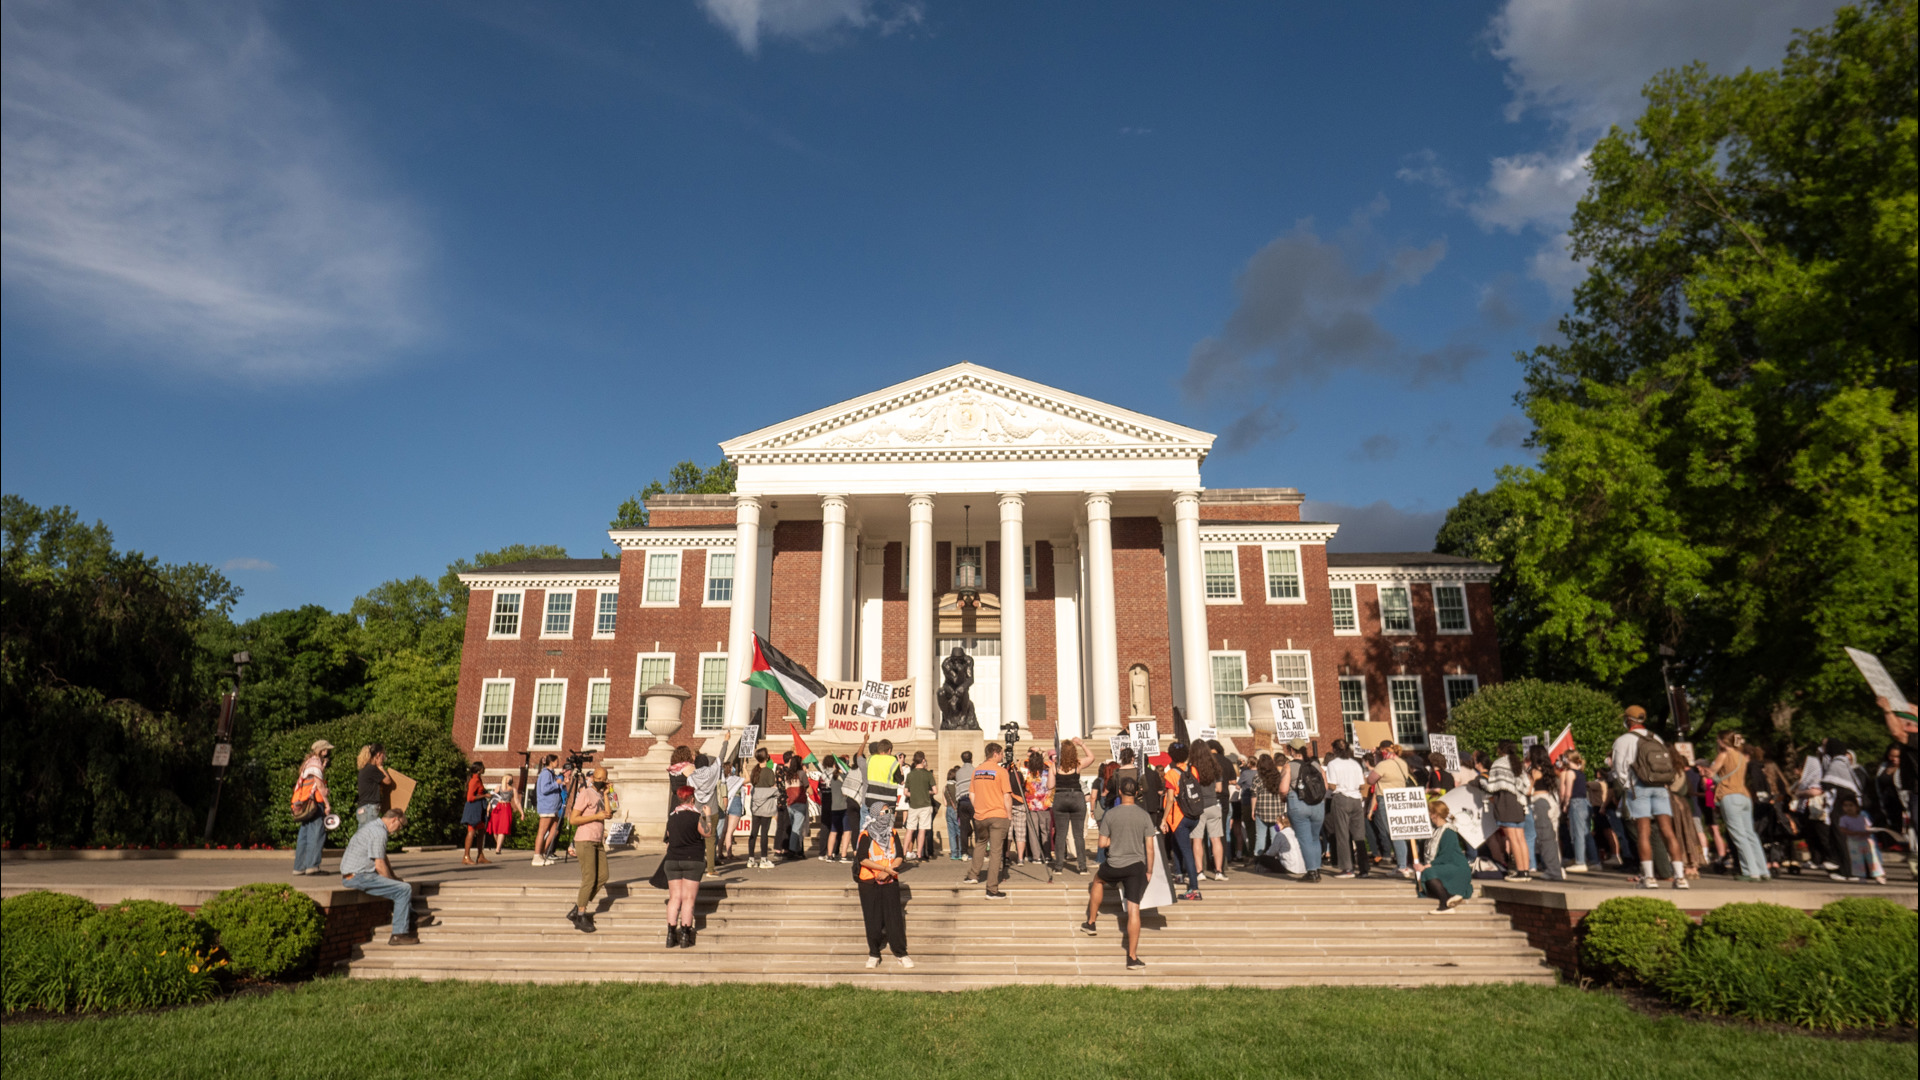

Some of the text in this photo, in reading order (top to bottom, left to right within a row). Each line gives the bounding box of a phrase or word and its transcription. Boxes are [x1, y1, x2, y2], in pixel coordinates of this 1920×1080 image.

[830, 688, 854, 700] LIFT
[892, 685, 912, 699] EGE
[866, 680, 890, 696] FREE
[862, 690, 889, 702] PALESTINE
[1278, 699, 1294, 709] END
[832, 703, 848, 716] ON
[1282, 710, 1296, 720] ALL
[828, 719, 858, 732] HANDS
[880, 717, 912, 732] RAFAH!
[1136, 723, 1150, 731] END
[1277, 721, 1304, 730] U.S. AID
[1138, 732, 1150, 740] ALL
[1386, 791, 1424, 802] FREE ALL
[1387, 802, 1426, 810] PALESTINIAN
[1390, 815, 1428, 825] POLITICAL
[1392, 825, 1430, 834] PRISONERS
